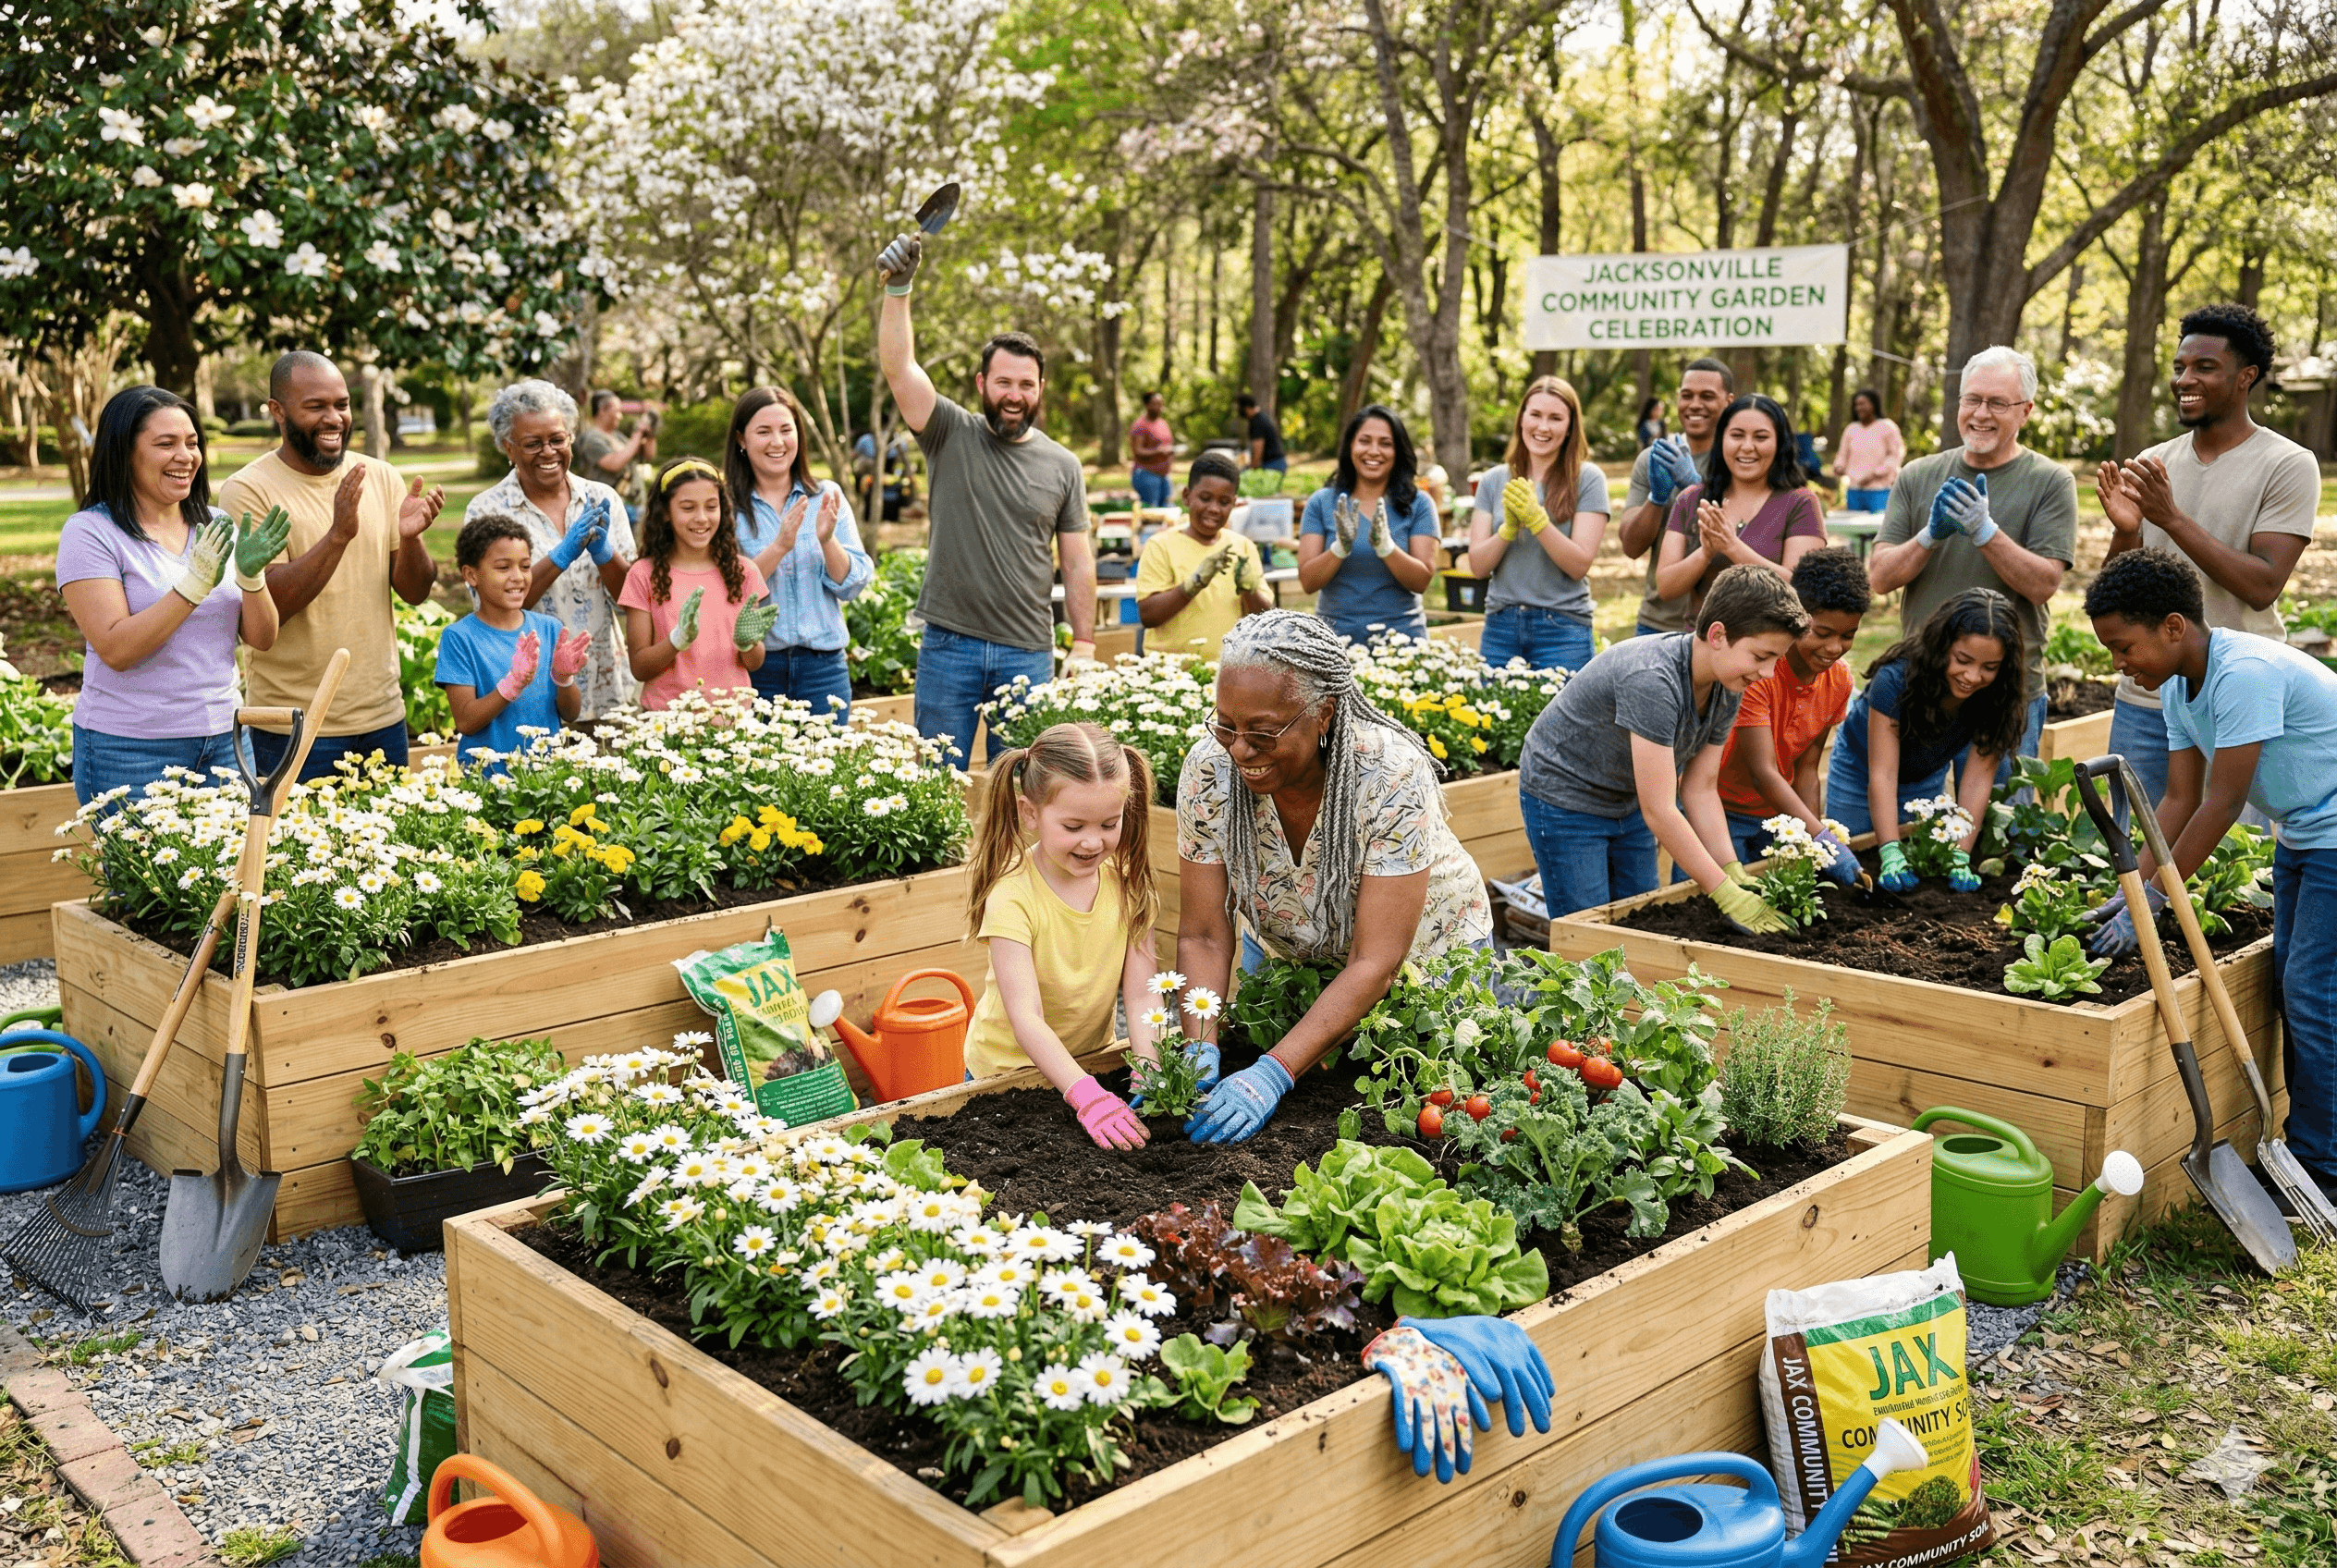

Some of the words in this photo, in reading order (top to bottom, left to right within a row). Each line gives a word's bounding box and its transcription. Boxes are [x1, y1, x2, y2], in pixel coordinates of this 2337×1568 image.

[1584, 257, 1782, 283] JACKSONVILLE
[1542, 290, 1700, 312] COMMUNITY
[1710, 286, 1826, 309] GARDEN
[1589, 316, 1773, 339] CELEBRATION
[744, 965, 802, 1007] JAX
[1782, 1357, 1808, 1390] JAX
[1868, 1332, 1960, 1401] JAX
[1792, 1395, 1828, 1509] COMMUNITY
[1888, 1535, 1967, 1568] COMMUNITY
[1969, 1519, 1989, 1543] SOIL
